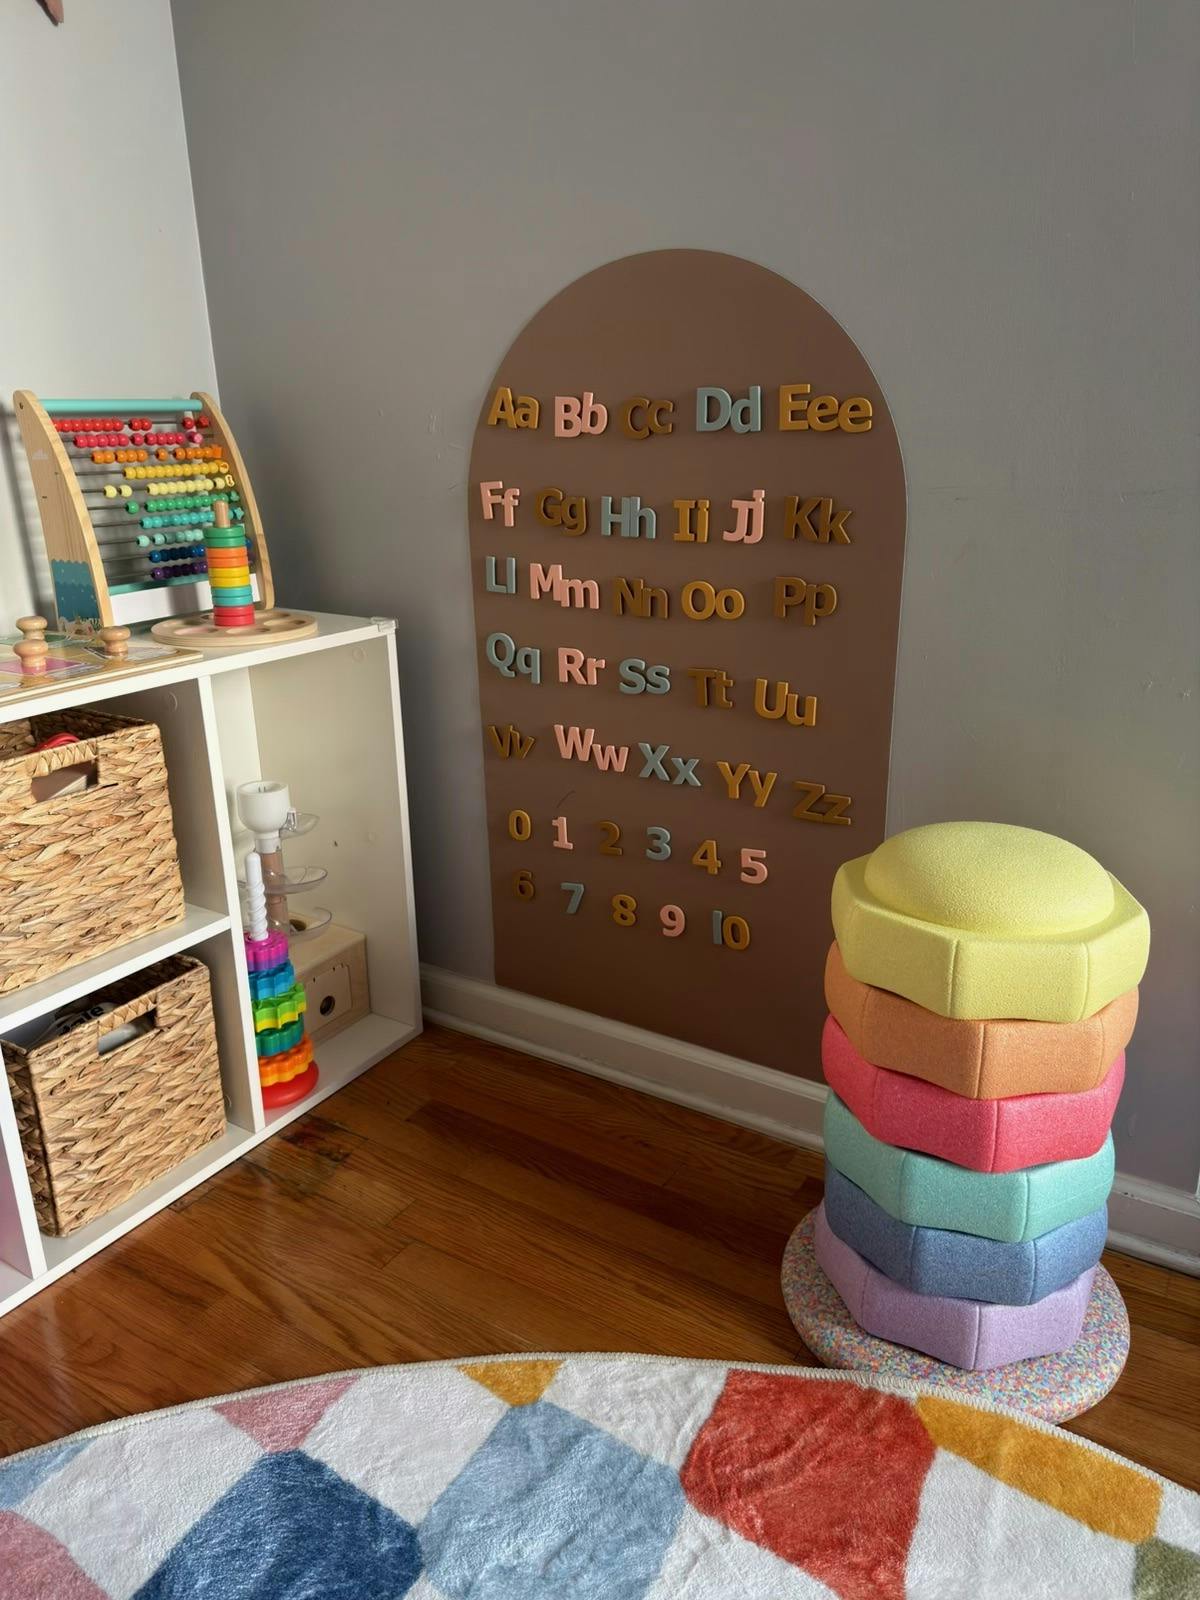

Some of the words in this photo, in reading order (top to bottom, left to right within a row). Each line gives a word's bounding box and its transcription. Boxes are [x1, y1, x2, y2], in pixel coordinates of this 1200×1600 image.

[488, 387, 540, 429] Aa
[555, 392, 608, 438] Bb
[621, 397, 674, 440] Cc
[696, 386, 762, 434] Dd
[779, 384, 873, 433] Eee
[480, 481, 520, 527] Ff
[535, 487, 587, 537] Gg
[601, 496, 657, 539] Hh
[673, 499, 710, 543] Ii
[723, 489, 766, 544] Jj
[784, 496, 852, 544] Kk
[486, 556, 516, 594] Ll
[529, 563, 600, 609] Mm
[613, 576, 669, 619] Nn
[681, 580, 745, 621] Oo
[774, 576, 838, 626] Pp
[486, 632, 541, 685] Qq
[557, 647, 606, 685] Rr
[619, 658, 671, 695] Ss
[688, 668, 734, 709] Tt
[754, 678, 817, 727] Uu
[488, 724, 535, 760] Vv
[554, 724, 629, 772] Ww
[637, 742, 701, 786] Xx
[716, 761, 778, 808] Yy
[793, 781, 851, 825] Zz
[508, 809, 532, 841] 0
[552, 816, 574, 850] 1
[599, 821, 622, 856] 2
[646, 826, 671, 861] 3
[692, 839, 721, 875] 4
[740, 848, 768, 884] 5
[513, 870, 535, 899] 6
[560, 882, 585, 914] 7
[612, 894, 637, 926] 8
[659, 904, 685, 937] 9
